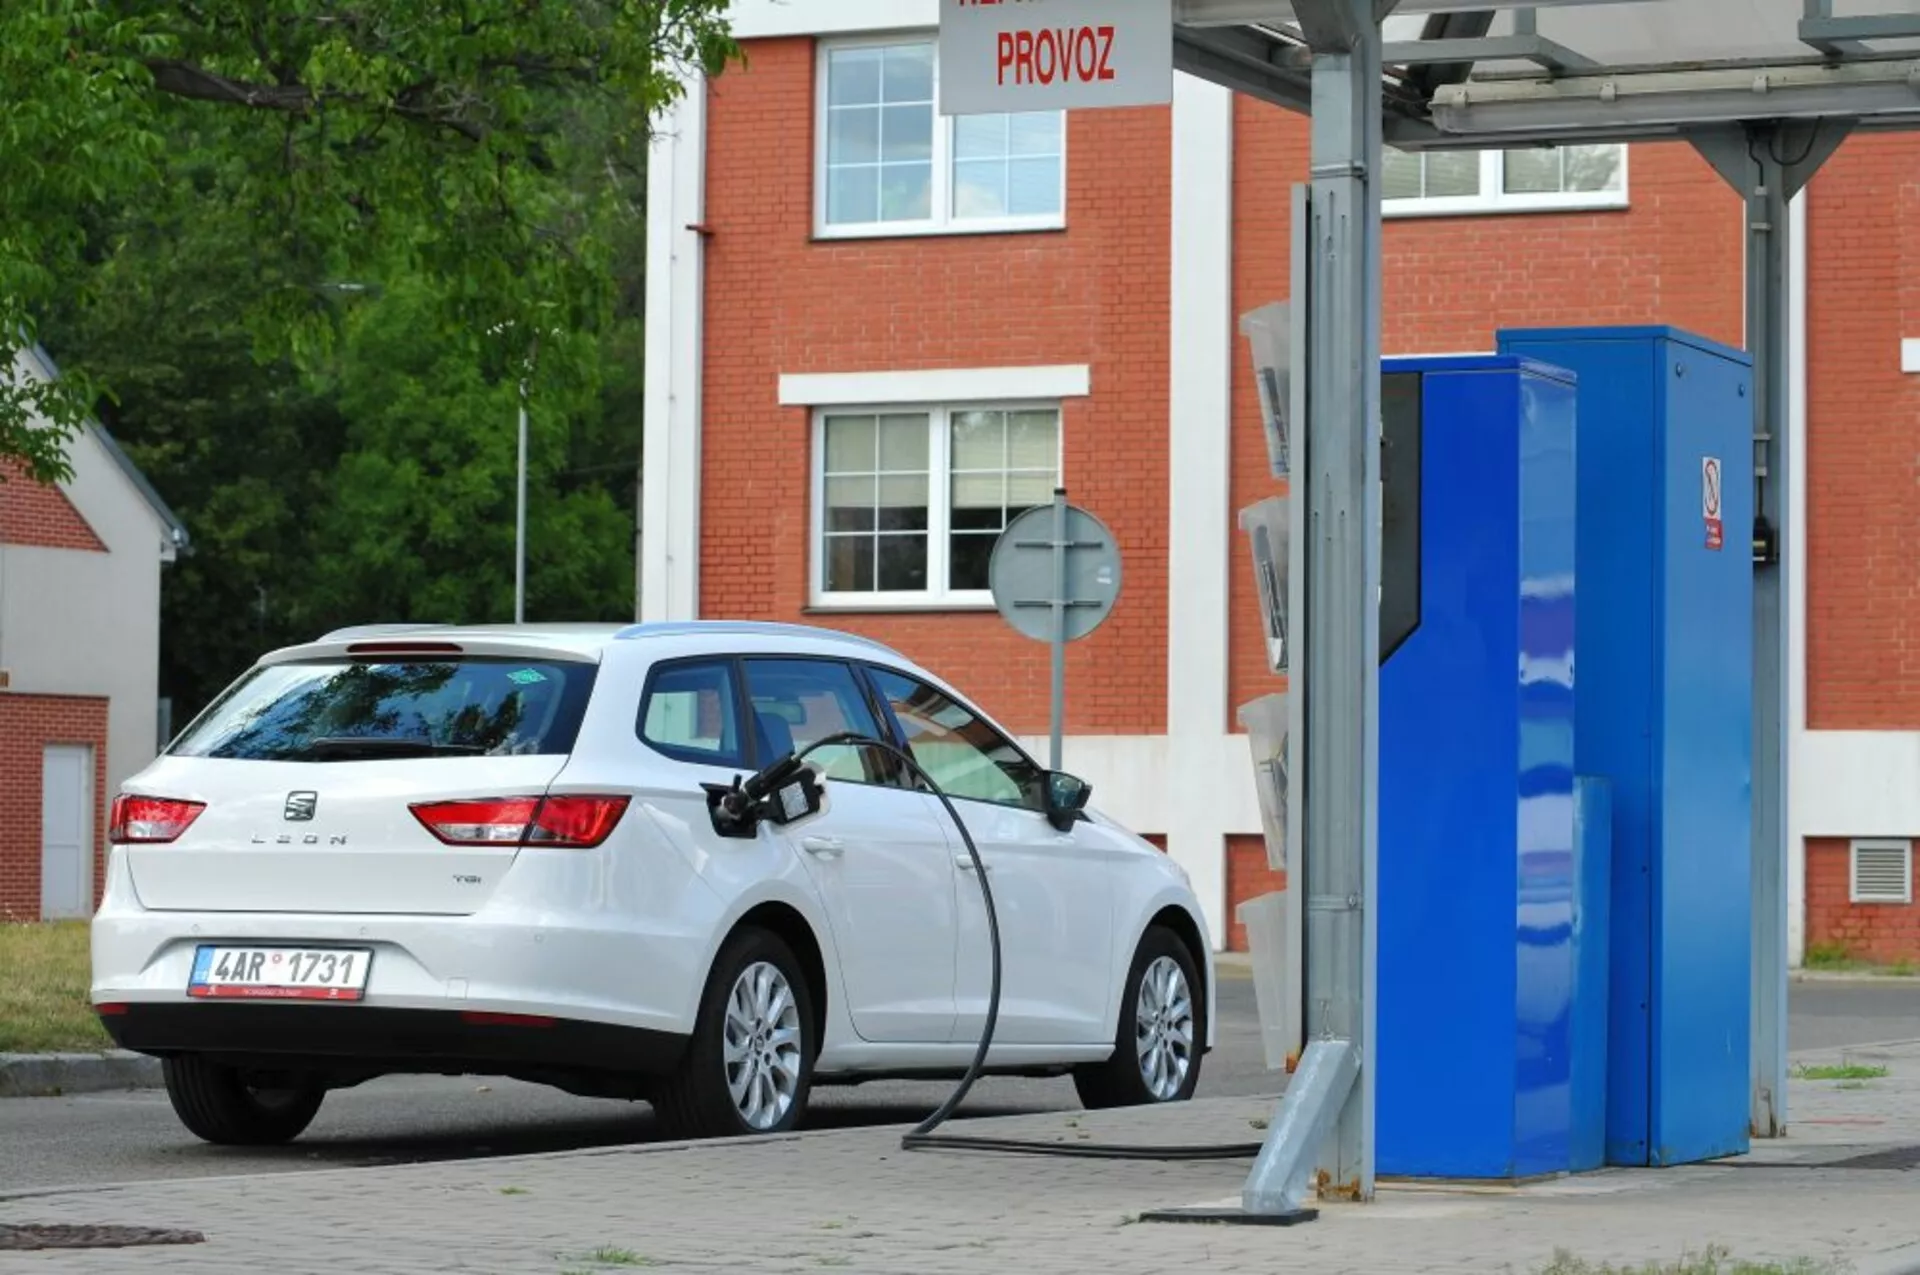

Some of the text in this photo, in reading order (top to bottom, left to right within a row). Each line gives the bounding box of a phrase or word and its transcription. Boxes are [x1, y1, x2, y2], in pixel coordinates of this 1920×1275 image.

[998, 26, 1115, 85] PROVOZ
[251, 834, 347, 845] LEON
[214, 952, 266, 981] 4AR
[289, 953, 354, 984] 1731
